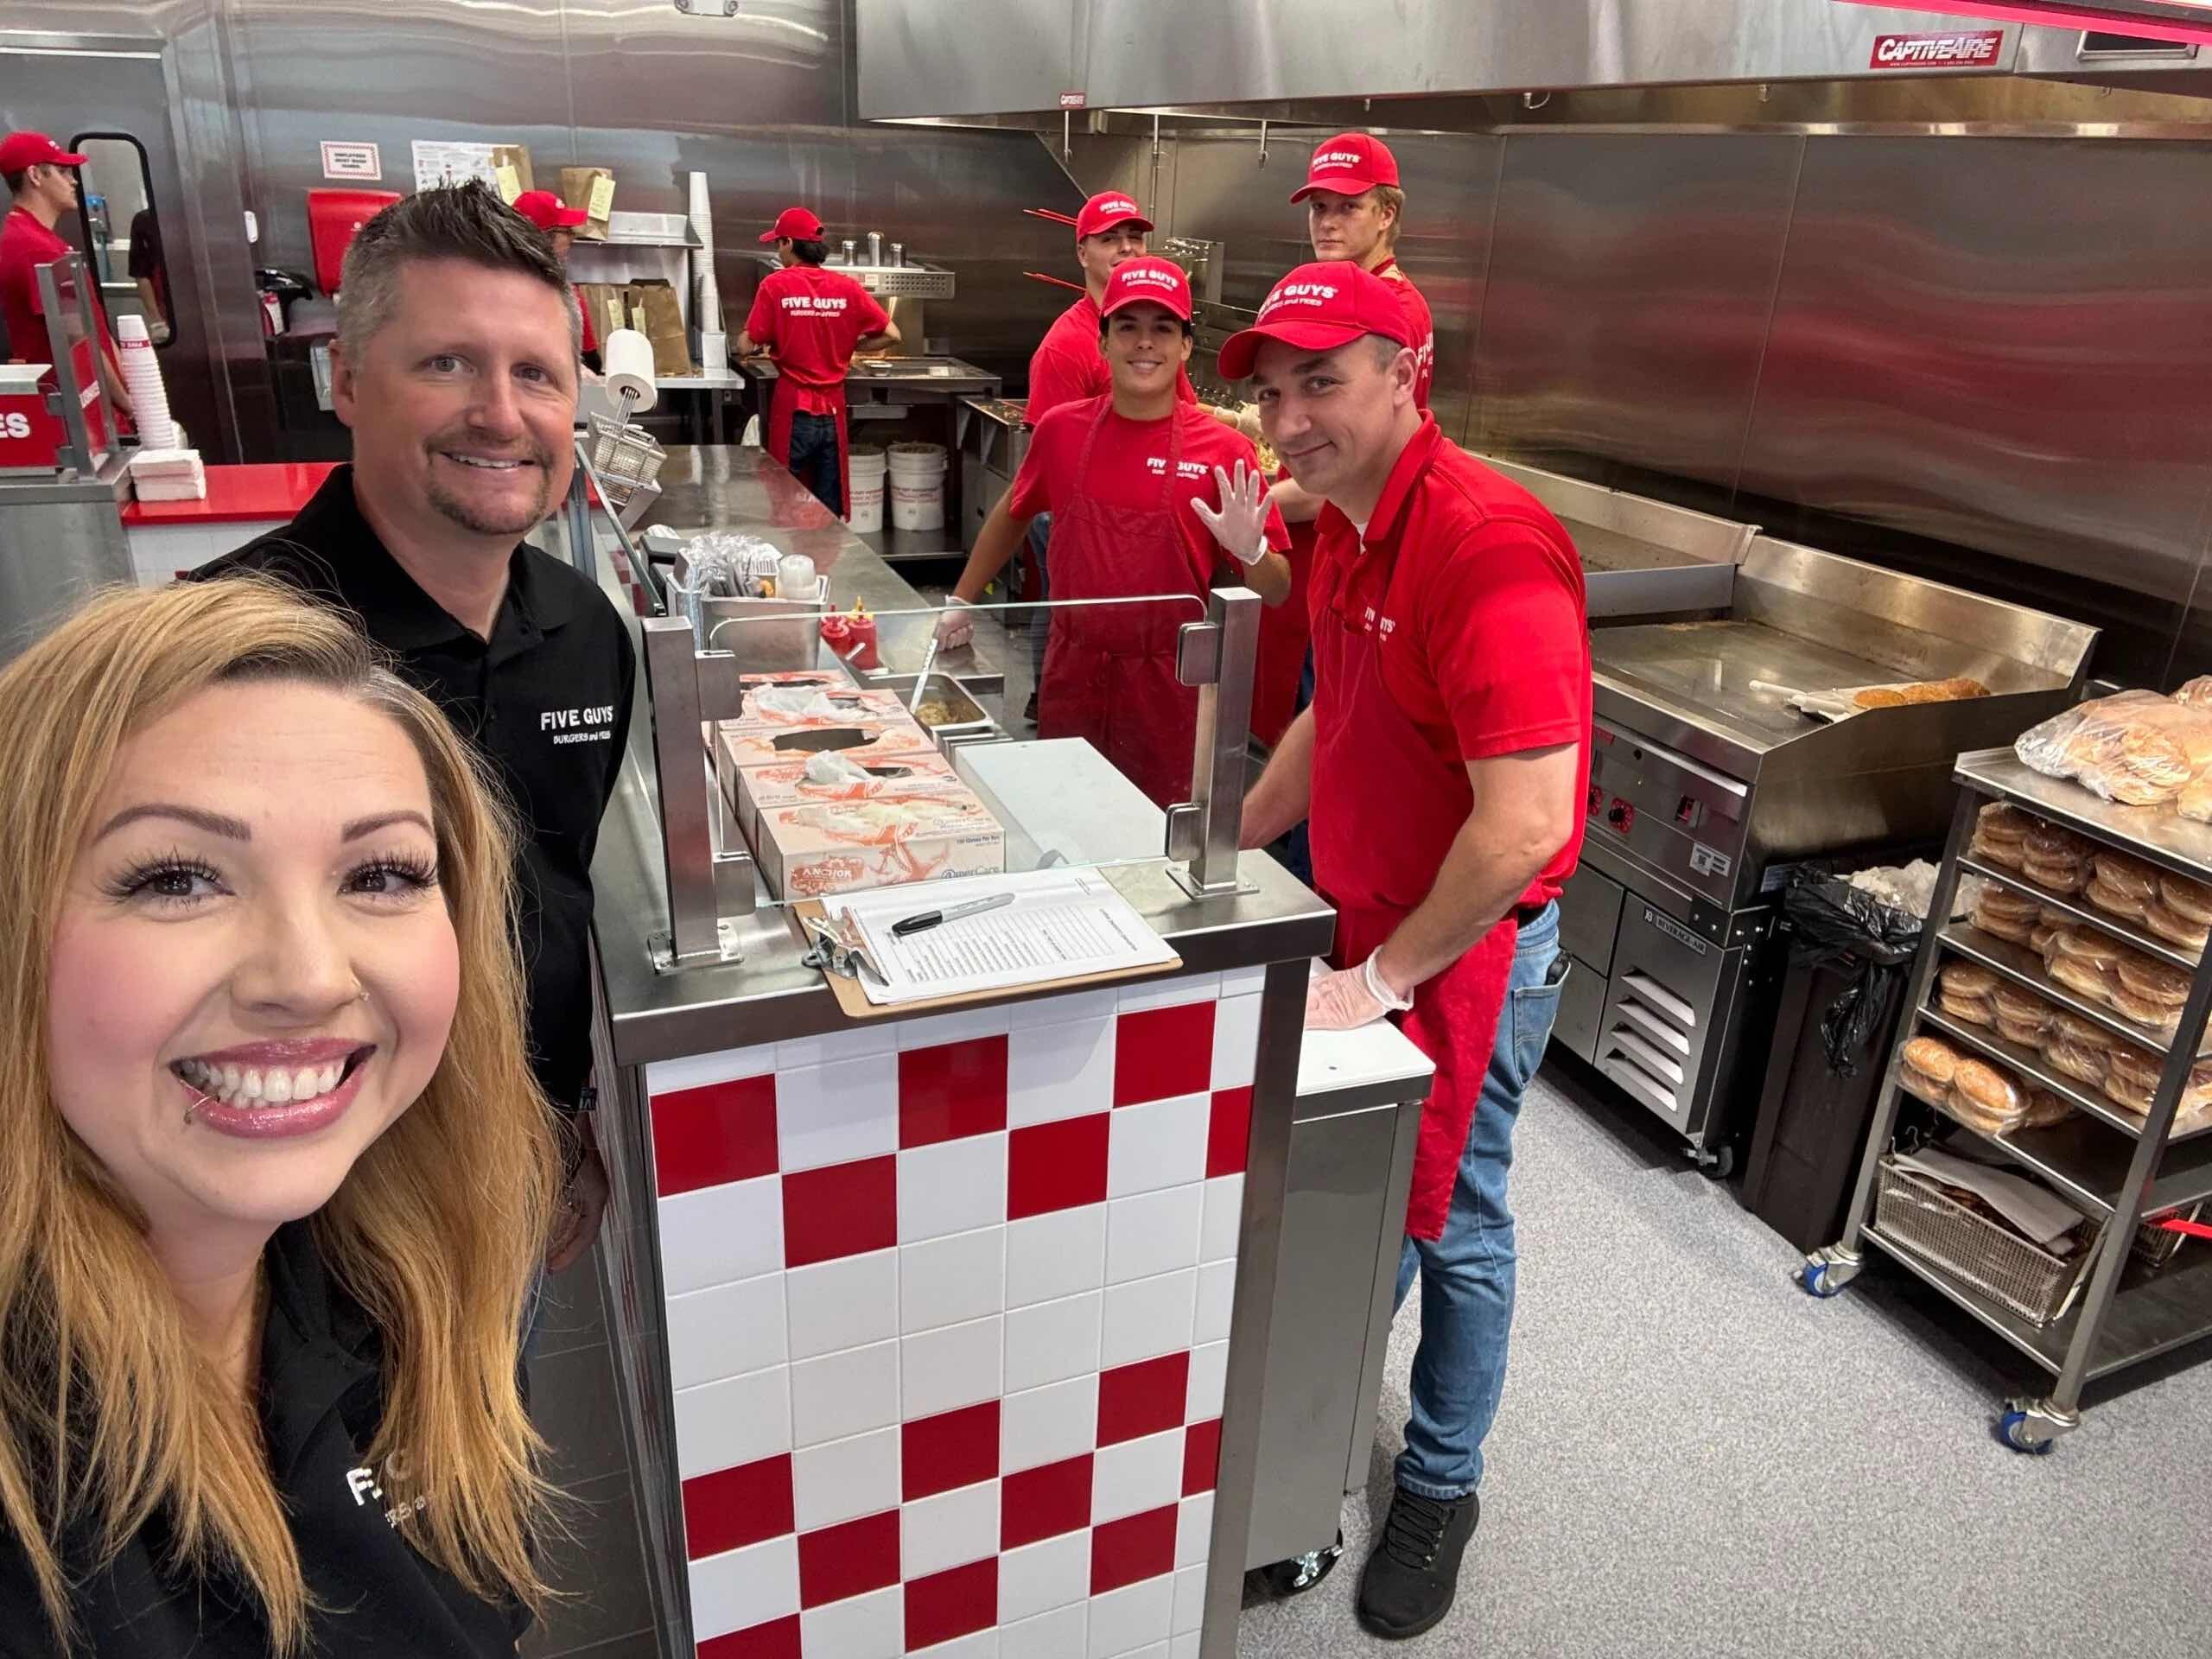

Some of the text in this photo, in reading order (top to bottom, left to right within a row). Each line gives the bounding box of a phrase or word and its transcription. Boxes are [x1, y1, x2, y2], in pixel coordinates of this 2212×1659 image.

[1284, 284, 1334, 299] GUYS
[781, 296, 847, 309] FIVE GUYS
[1147, 457, 1166, 468] FIV
[541, 705, 613, 731] FIVE GUYS
[553, 732, 588, 745] BURGERS
